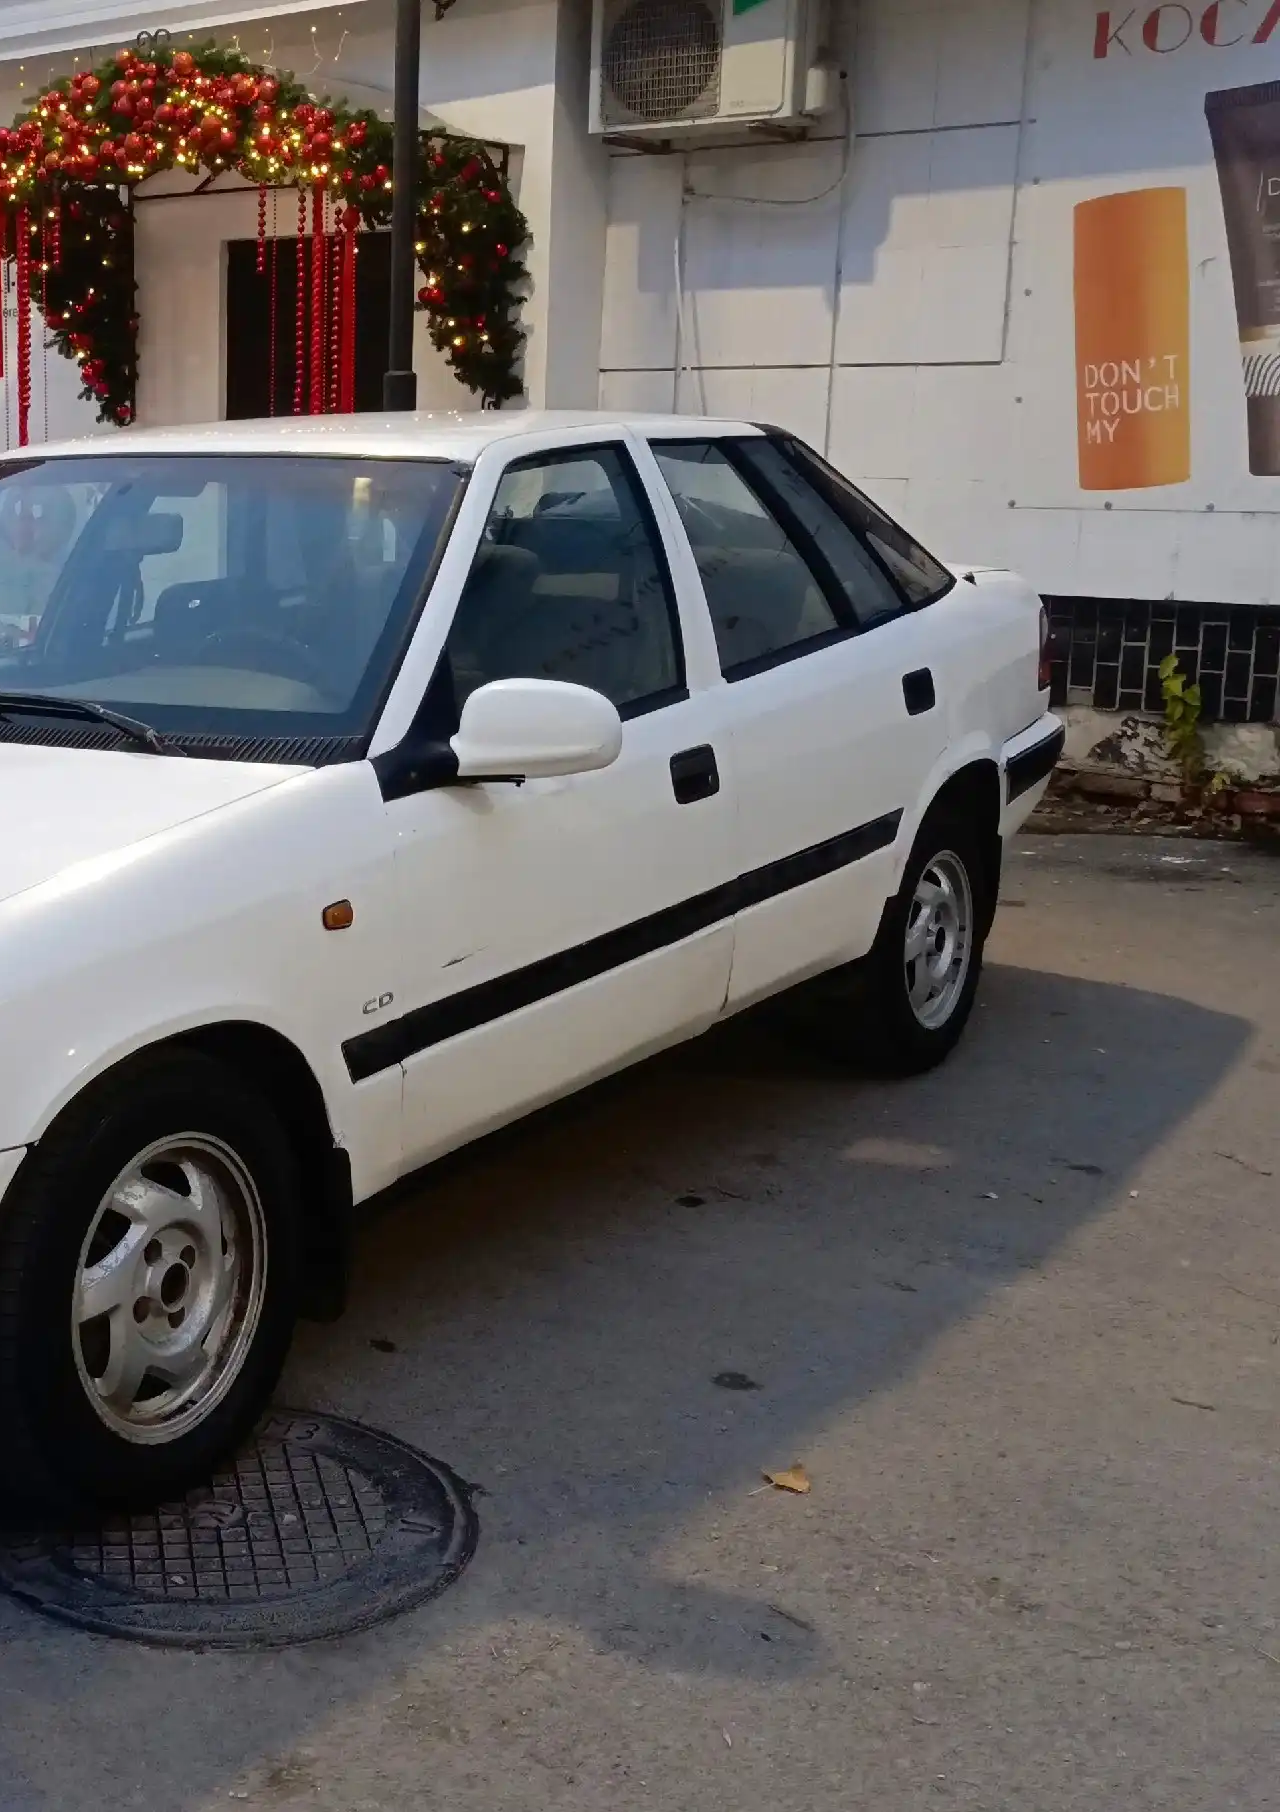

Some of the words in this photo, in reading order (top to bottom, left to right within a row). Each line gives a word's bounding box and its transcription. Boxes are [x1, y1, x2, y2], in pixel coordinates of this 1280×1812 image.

[1084, 354, 1179, 389] DON'T
[1085, 383, 1180, 417] TOUCH
[1086, 418, 1121, 444] MY
[362, 991, 394, 1015] CD
